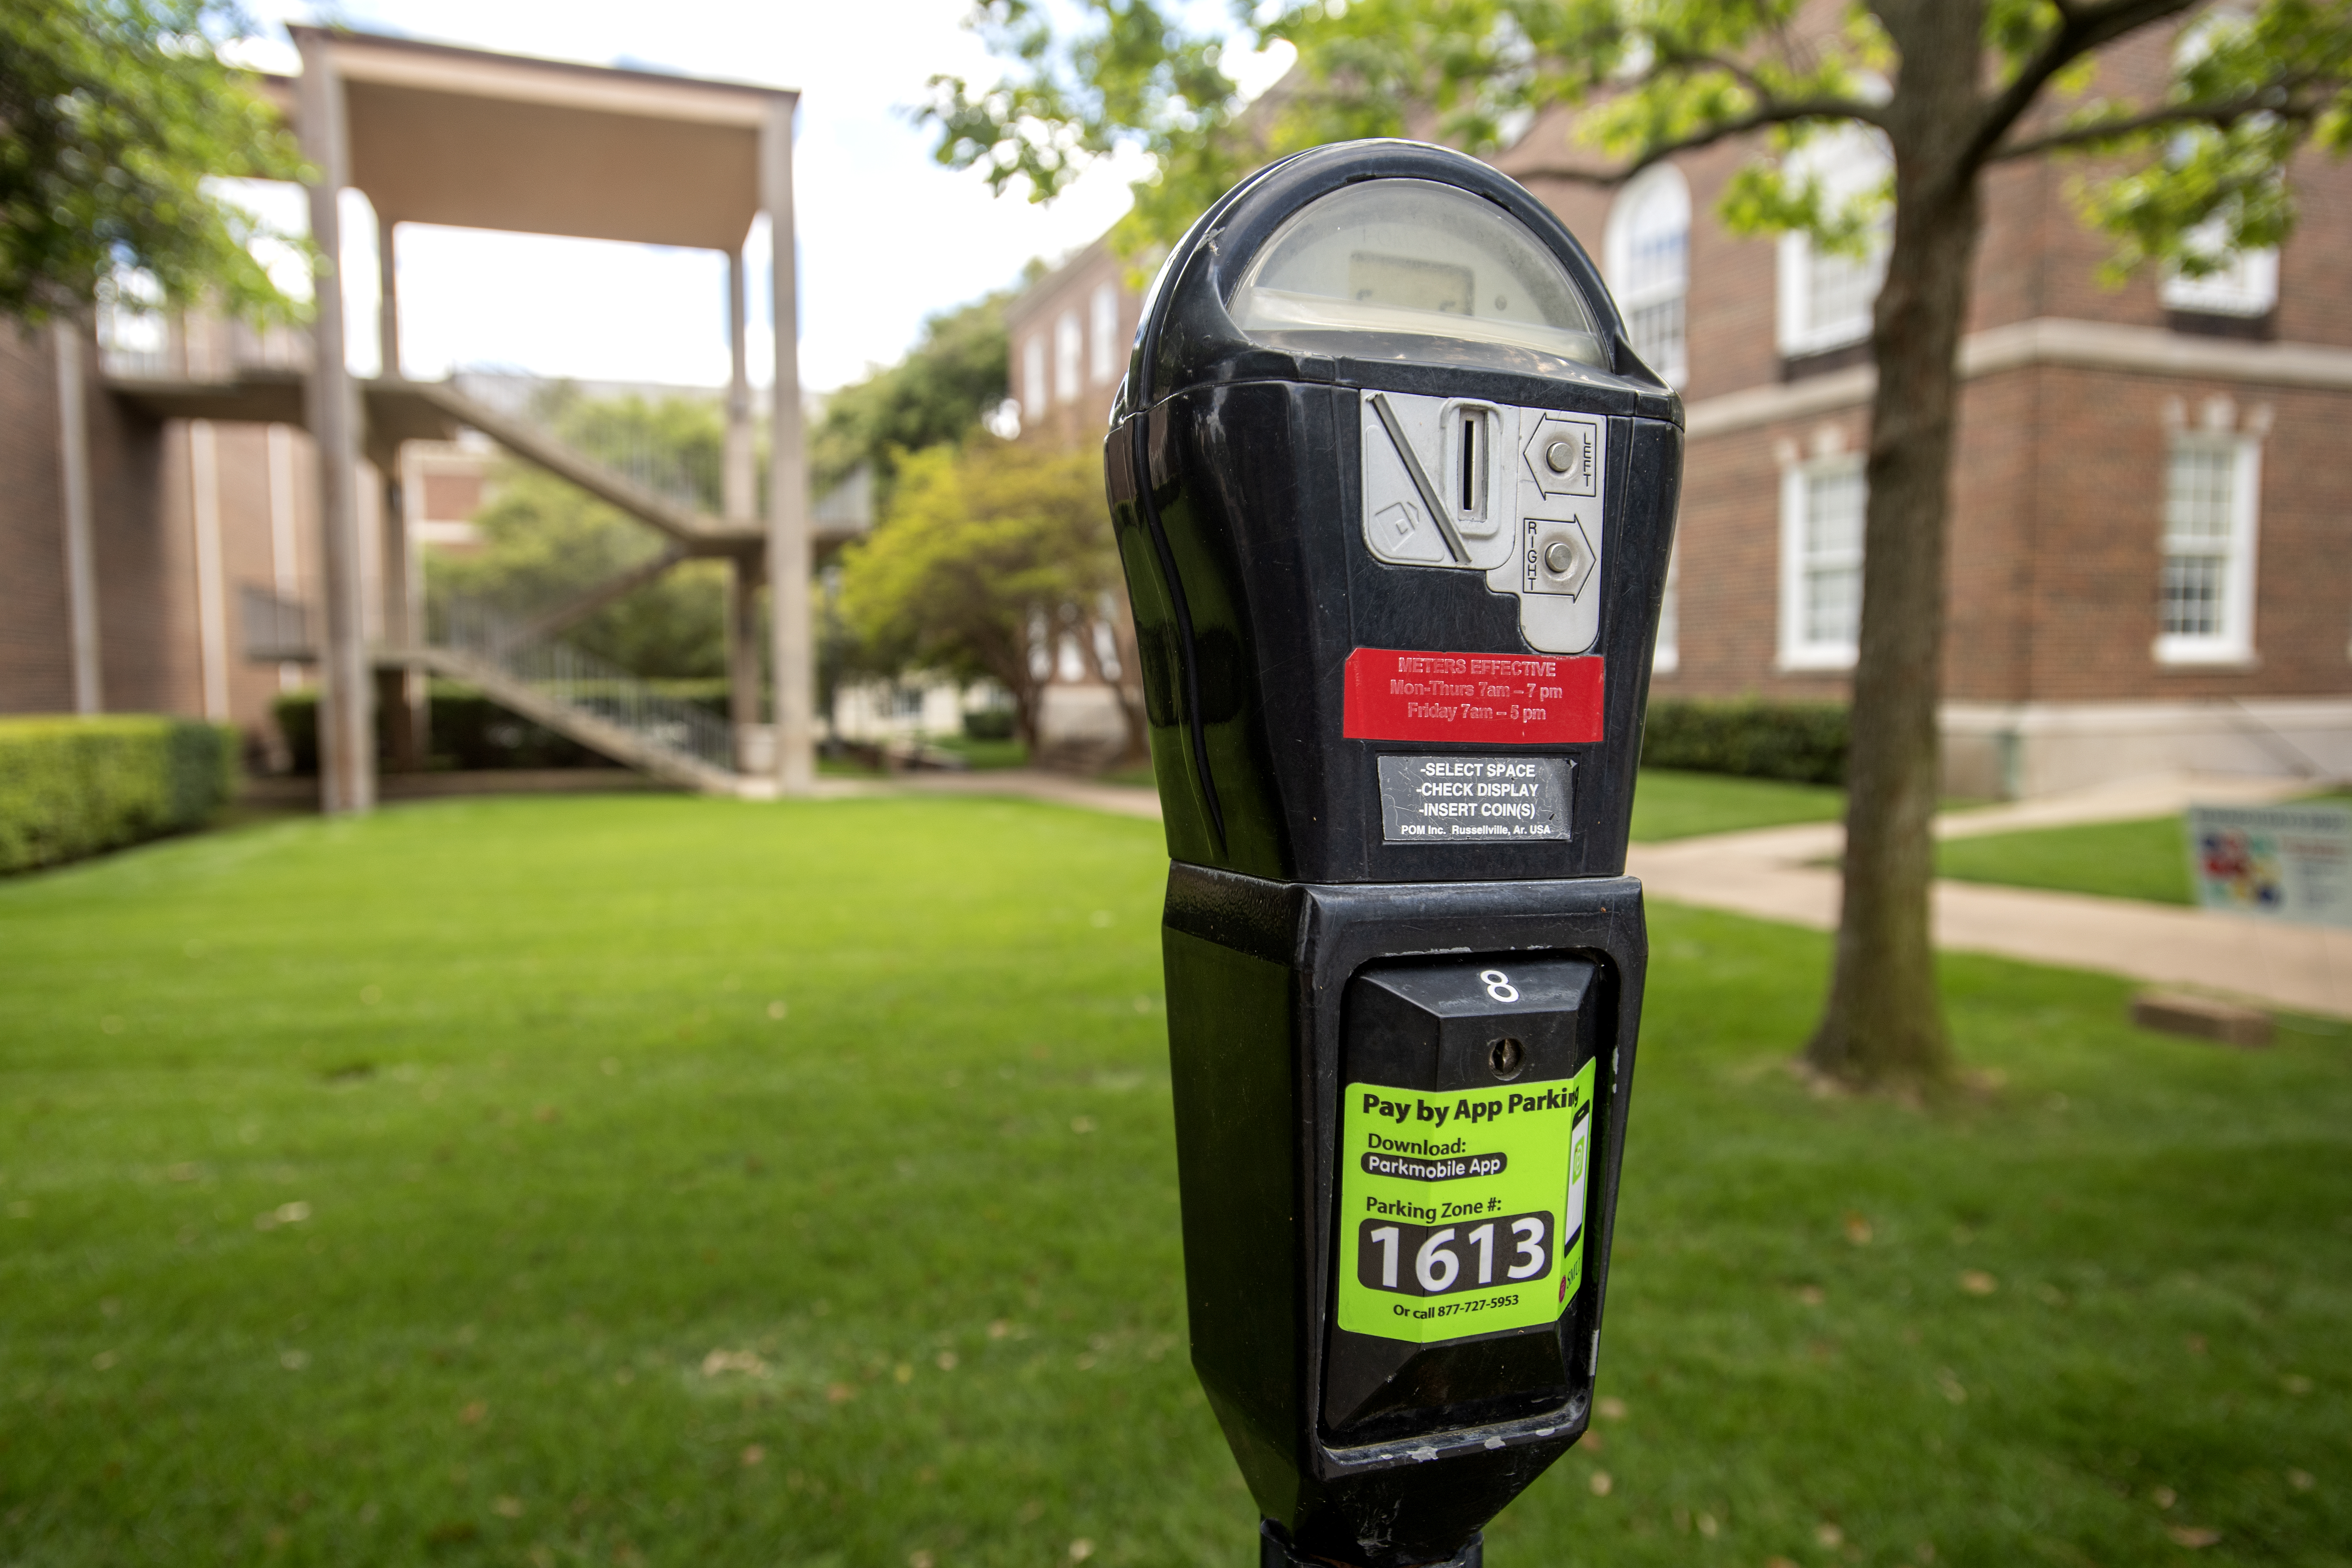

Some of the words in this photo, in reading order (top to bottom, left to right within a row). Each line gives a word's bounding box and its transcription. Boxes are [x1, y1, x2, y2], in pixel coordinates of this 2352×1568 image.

[1583, 433, 1592, 487] LEFT
[1527, 521, 1538, 591] RIGHT
[1398, 657, 1467, 674] METERS
[1471, 659, 1556, 677] EFFECTIVE
[1390, 679, 1474, 696] Mon-Thurs
[1478, 682, 1510, 697] 7am
[1527, 683, 1536, 697] 7
[1540, 687, 1563, 702] pm
[1408, 702, 1457, 721] Friday
[1461, 704, 1493, 719] 7am
[1510, 705, 1519, 720] 5
[1523, 708, 1546, 723] pm
[1420, 763, 1484, 776] -SELECT
[1487, 764, 1535, 778] SPACE
[1416, 782, 1473, 797] -CHECK
[1478, 784, 1539, 797] DISPLAY
[1419, 803, 1478, 817] -INSERT
[1481, 803, 1536, 819] COIN(S)
[1401, 825, 1425, 835] POM
[1428, 825, 1446, 835] Inc.
[1452, 825, 1511, 836] Russellville,
[1513, 825, 1527, 834] Ar.
[1530, 825, 1551, 834] USA
[1480, 970, 1519, 1003] 8
[1362, 1093, 1412, 1124] Pay
[1416, 1099, 1449, 1128] by
[1453, 1098, 1503, 1124] App
[1508, 1085, 1580, 1114] Parking
[1367, 1132, 1467, 1156] Download:
[1369, 1156, 1465, 1179] Parkmobile
[1469, 1157, 1501, 1176] App
[1366, 1196, 1437, 1224] Parking
[1441, 1199, 1483, 1219] Zone
[1487, 1197, 1502, 1212] #:
[1370, 1217, 1546, 1293] 1613
[1393, 1304, 1410, 1317] Or
[1413, 1307, 1435, 1319] call
[1437, 1294, 1519, 1318] 877-727-5953
